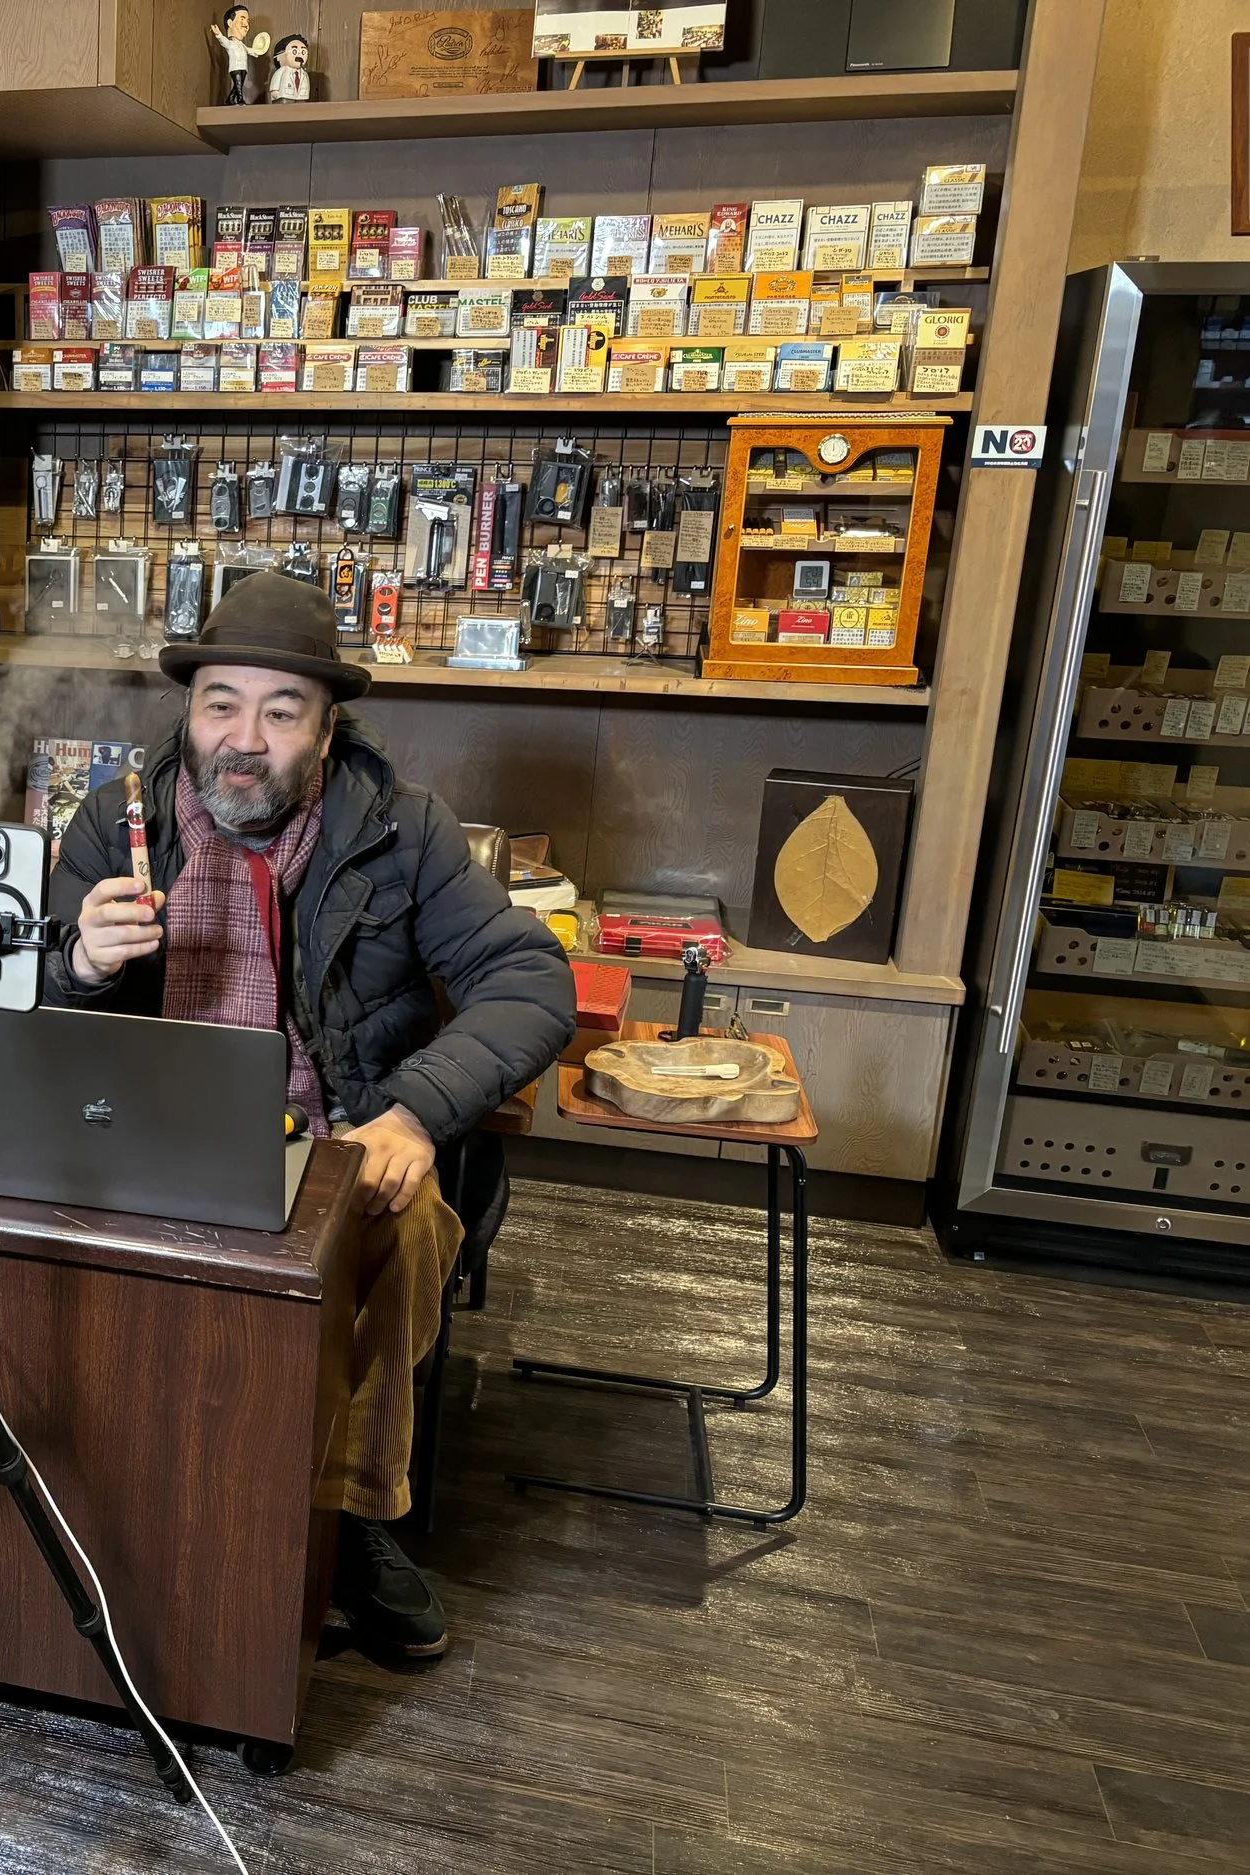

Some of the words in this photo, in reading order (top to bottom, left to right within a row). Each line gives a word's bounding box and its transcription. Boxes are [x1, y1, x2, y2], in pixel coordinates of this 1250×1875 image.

[502, 204, 527, 214] TOSCANO
[757, 214, 794, 224] CHAZZ
[820, 214, 858, 225] CHAZZ
[877, 213, 906, 221] CHAZZ
[659, 223, 704, 238] MEHARI'S
[408, 295, 438, 304] CLUB
[479, 490, 495, 552] BURNER
[474, 557, 488, 587] PEN
[733, 613, 759, 626] Zino
[795, 616, 813, 624] Zino
